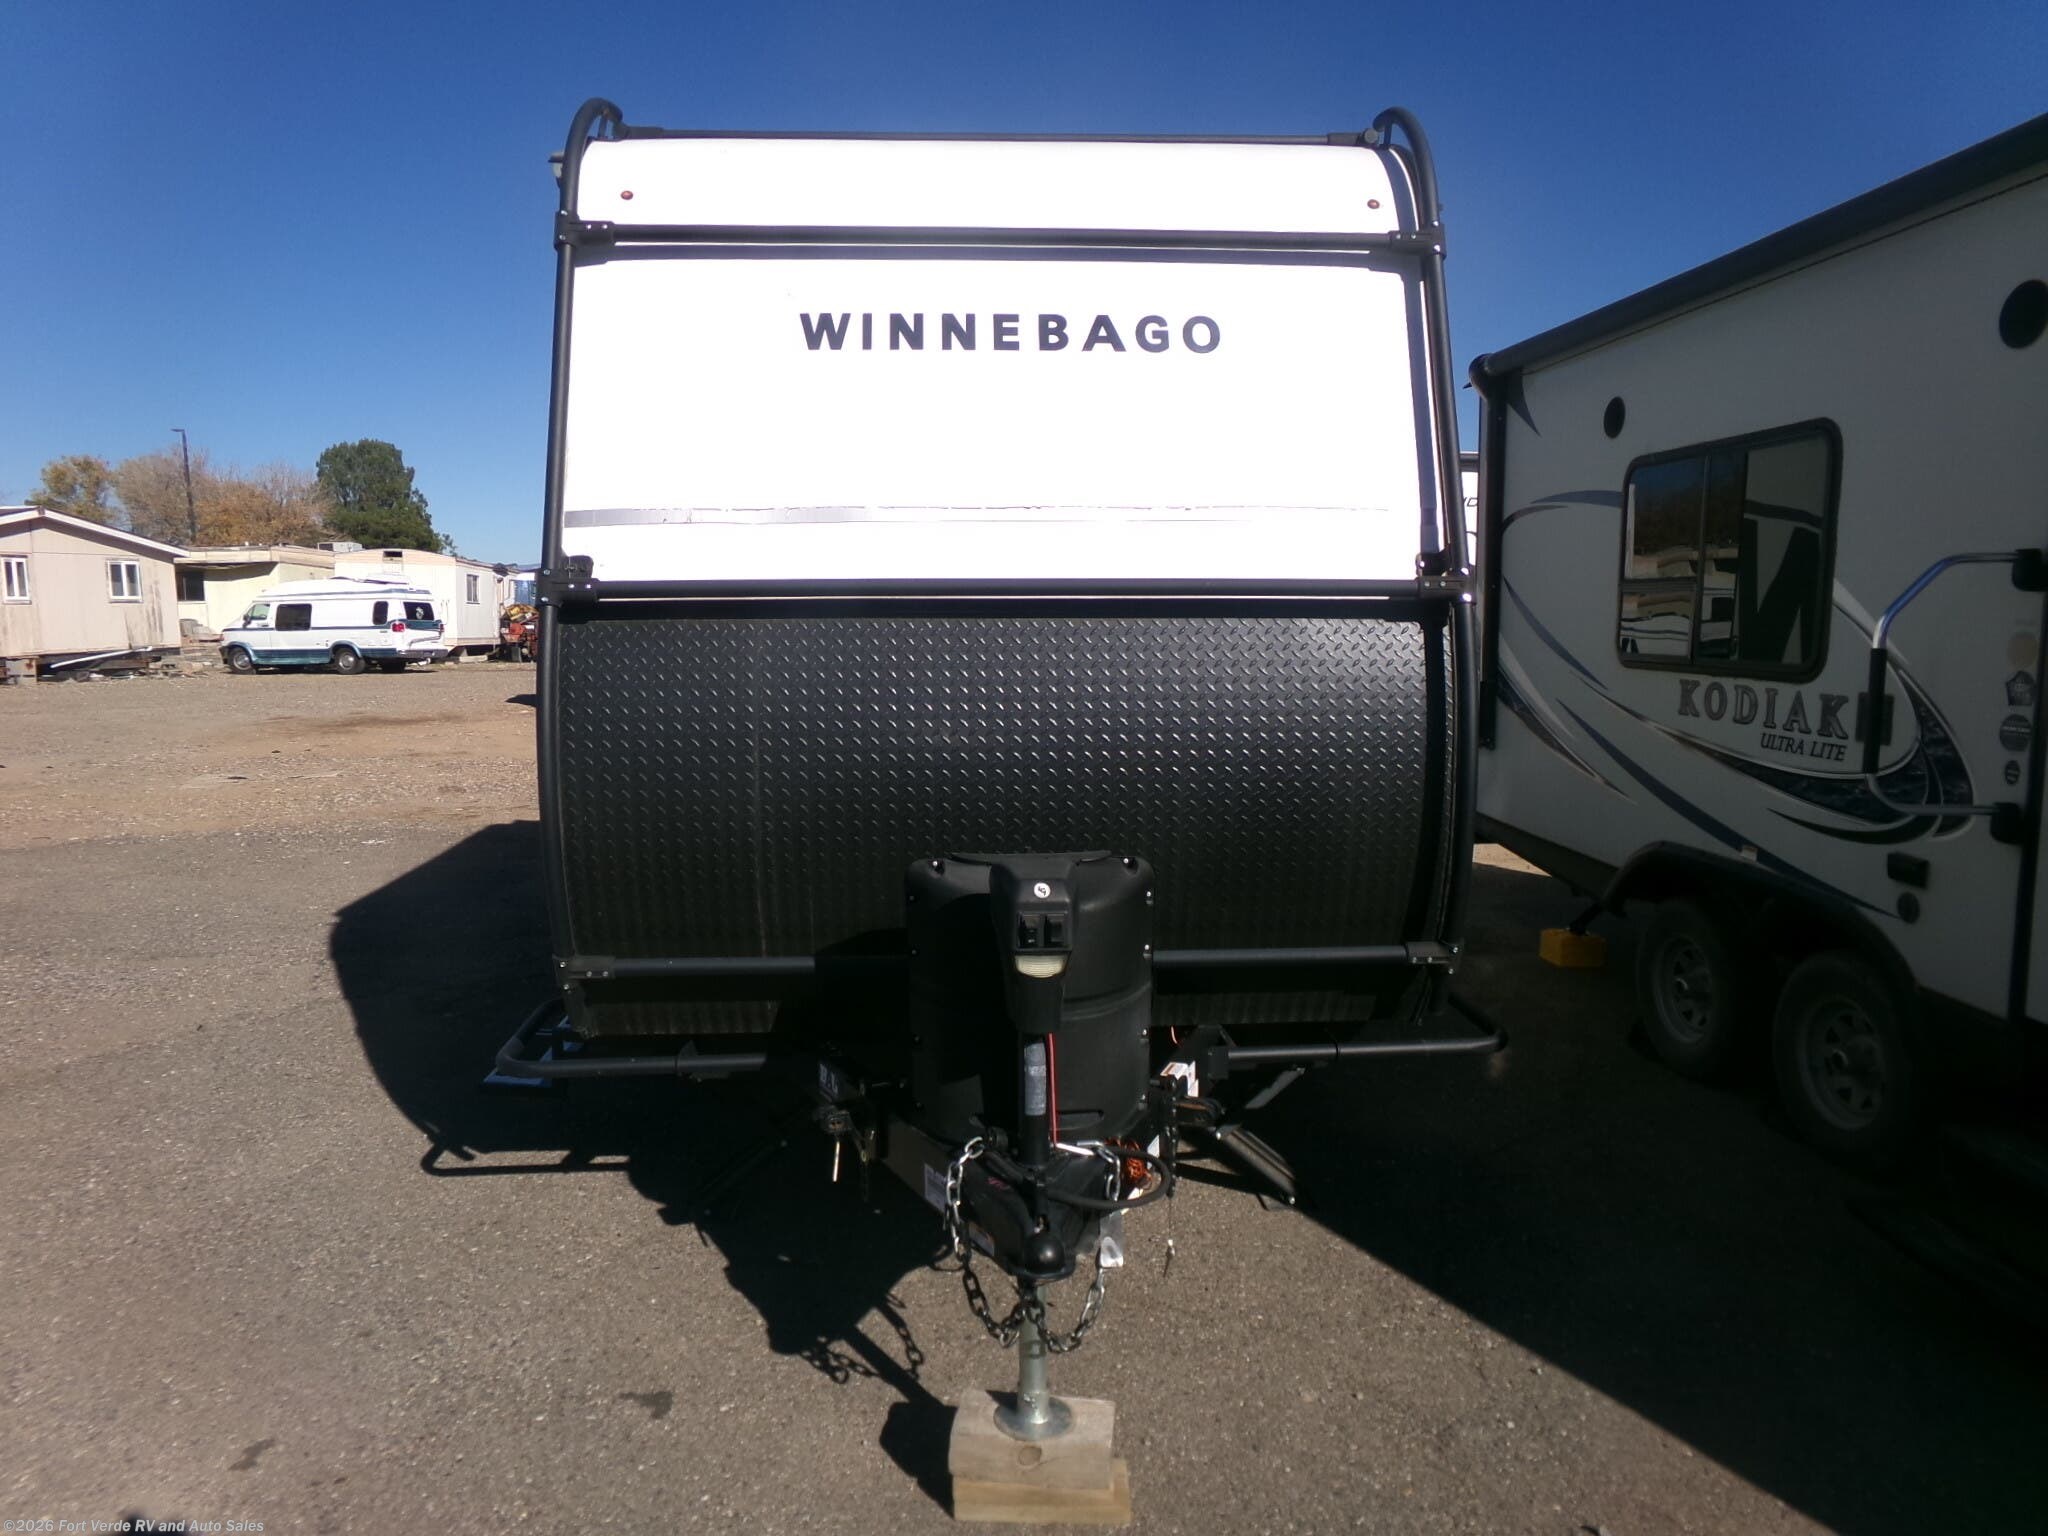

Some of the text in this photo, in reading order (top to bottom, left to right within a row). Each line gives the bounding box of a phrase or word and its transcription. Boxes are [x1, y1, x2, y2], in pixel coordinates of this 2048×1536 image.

[800, 312, 1221, 354] WINNEBAGO
[1678, 678, 1849, 740] KODIAK
[1760, 732, 1848, 762] ULTRA LITE
